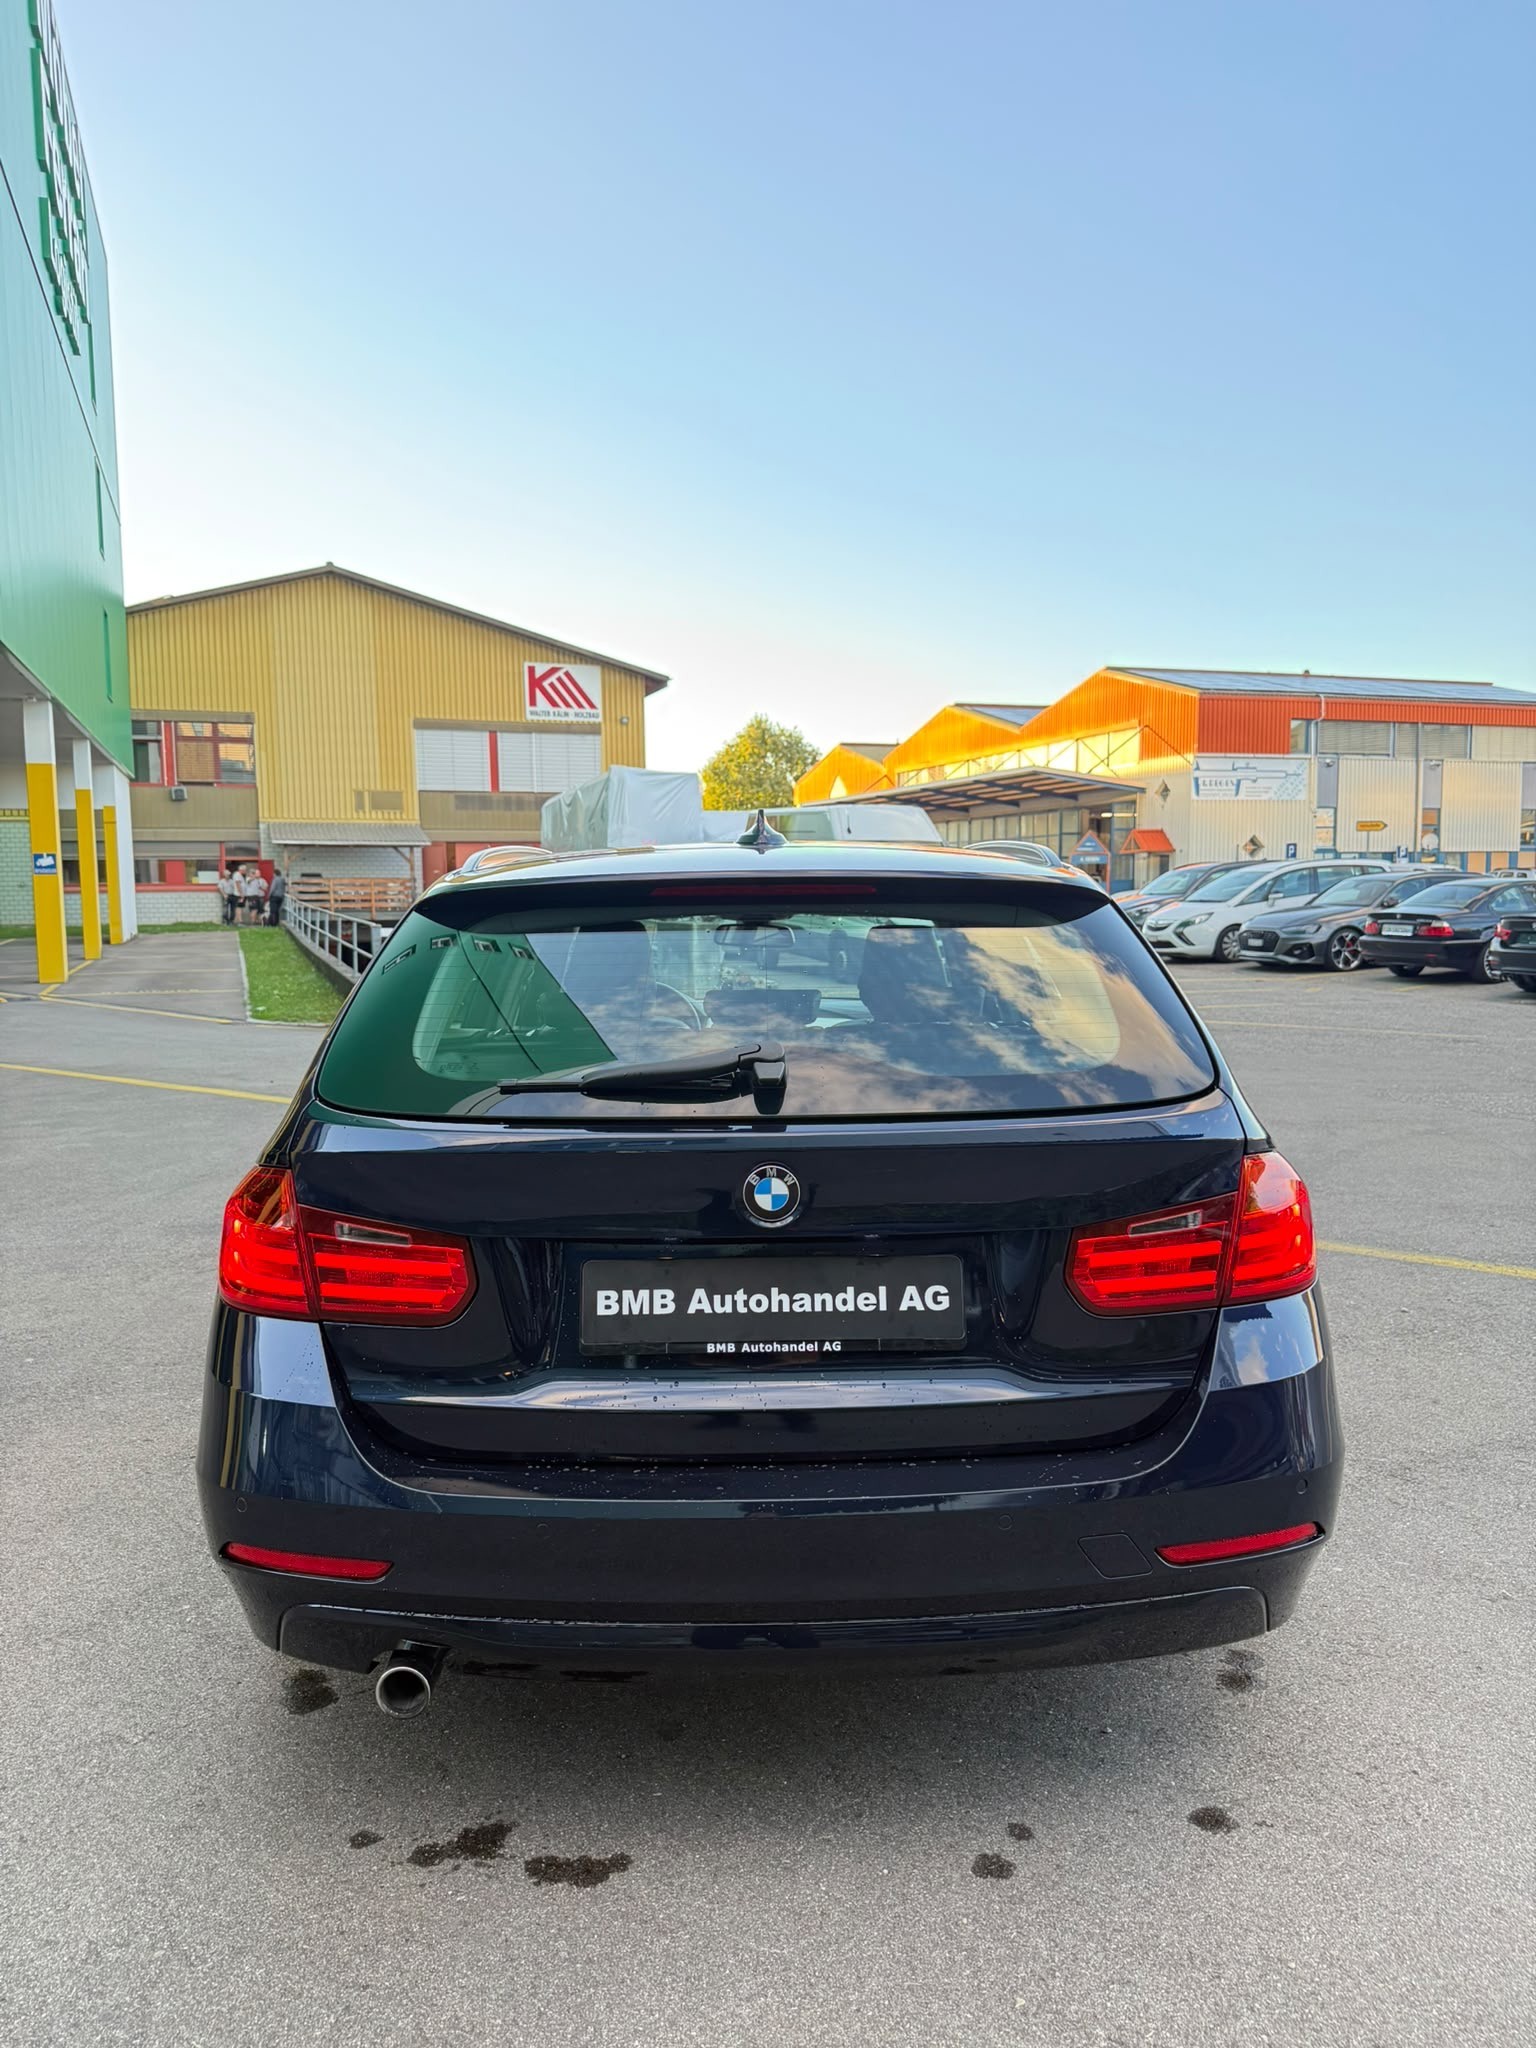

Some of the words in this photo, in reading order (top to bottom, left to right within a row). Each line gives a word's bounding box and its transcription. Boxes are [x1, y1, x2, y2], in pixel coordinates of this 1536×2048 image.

[749, 1167, 795, 1186] BMW
[596, 1288, 676, 1316] BMB
[688, 1285, 887, 1315] Autohandel
[900, 1284, 951, 1312] AG
[706, 1342, 736, 1353] BMB
[741, 1341, 819, 1353] Autohandel
[823, 1341, 842, 1352] AG
